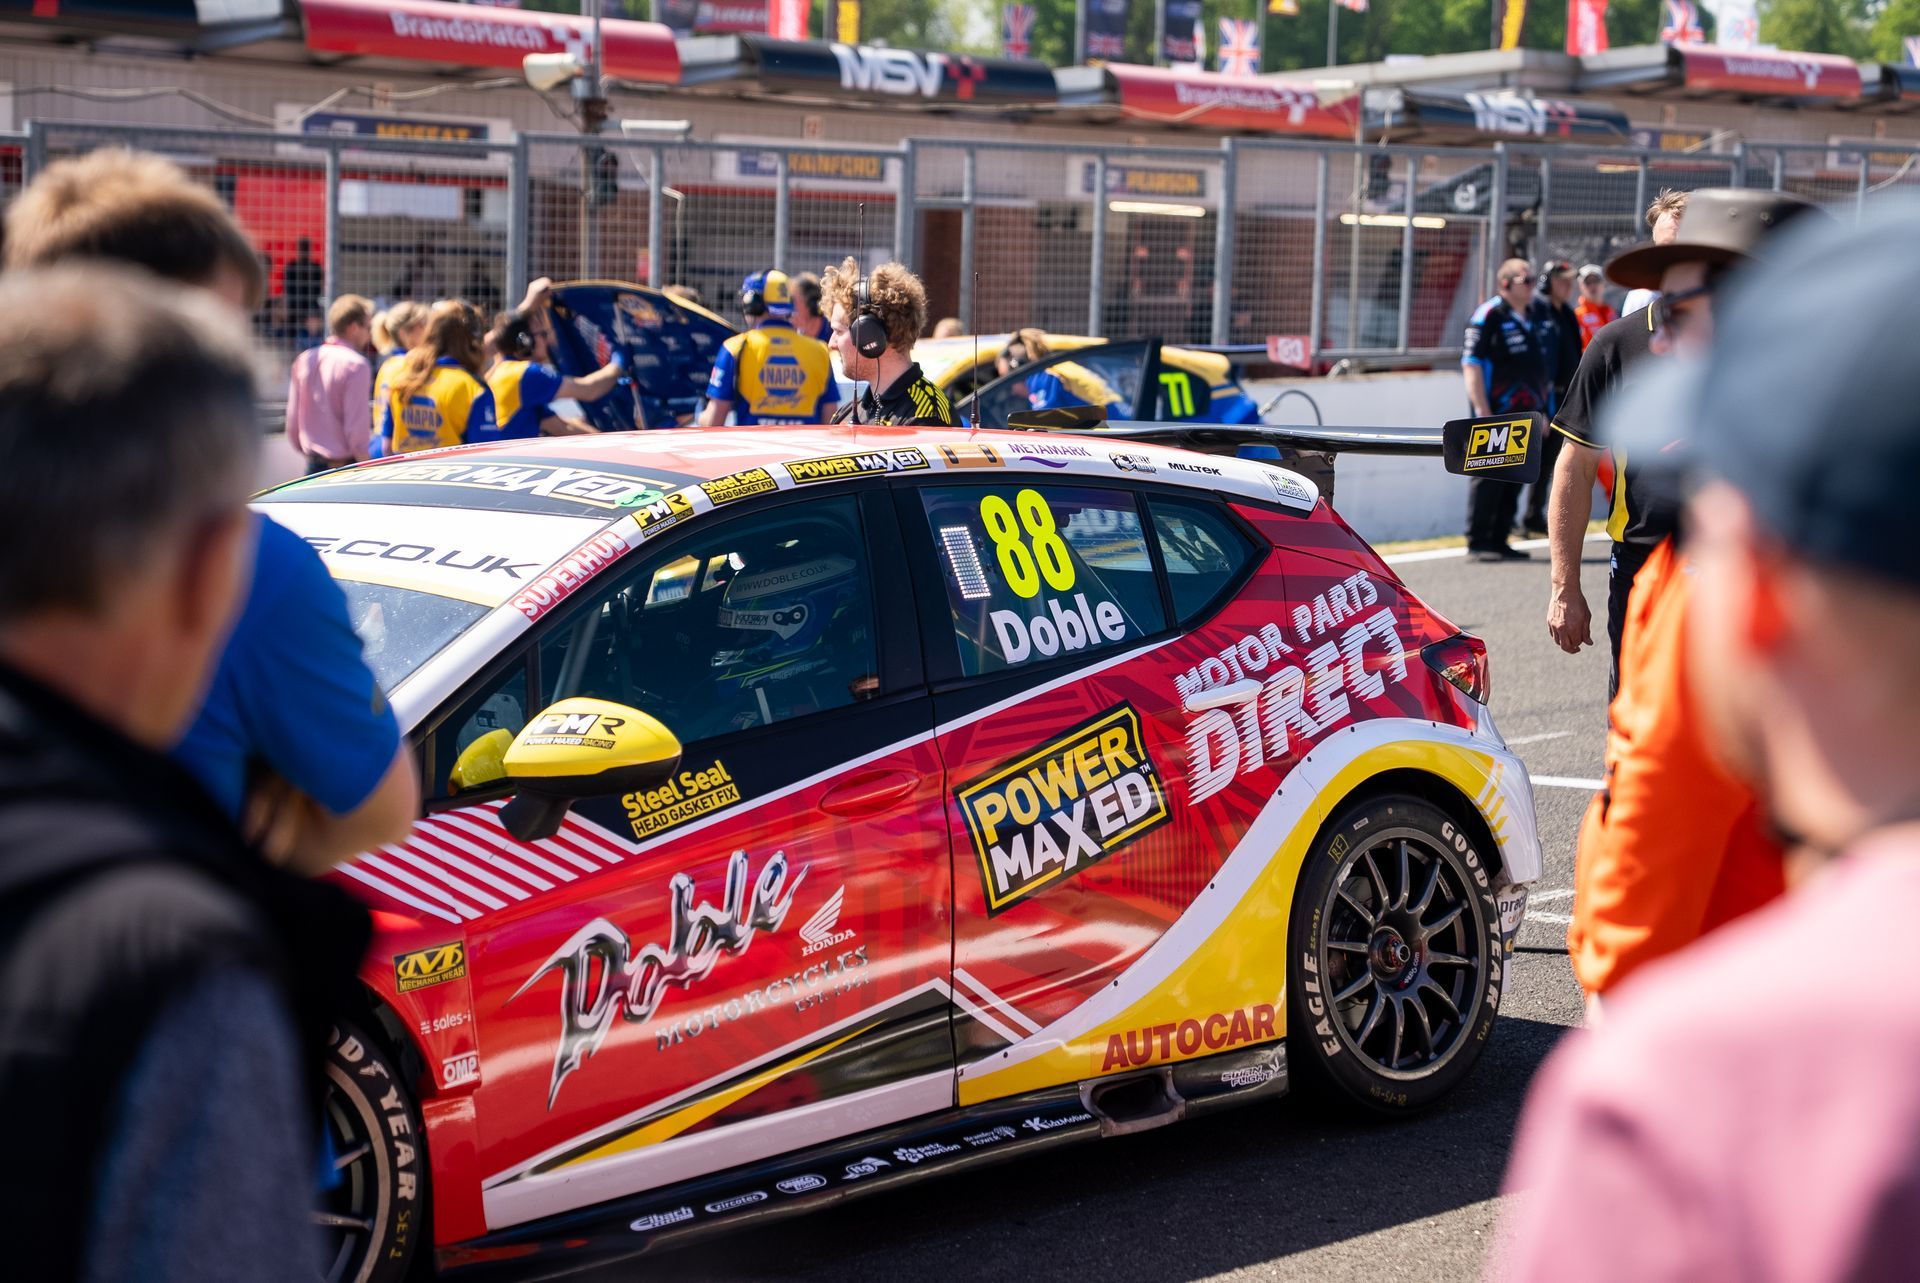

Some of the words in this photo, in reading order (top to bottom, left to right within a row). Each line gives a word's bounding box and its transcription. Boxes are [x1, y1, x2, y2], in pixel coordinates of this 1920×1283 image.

[829, 43, 941, 97] MSV
[766, 366, 800, 386] NAPA
[1159, 372, 1196, 417] 77
[404, 406, 437, 428] NAPA
[1007, 443, 1092, 458] METAMARK
[1470, 425, 1527, 455] PMR
[700, 475, 740, 494] Steel
[735, 468, 770, 485] Seal
[790, 456, 860, 479] POWER
[856, 449, 921, 472] MAXED
[1467, 458, 1486, 469] POWER
[1486, 457, 1505, 466] MAXED
[1505, 455, 1524, 464] RACING
[449, 466, 648, 503] MAXED
[711, 490, 734, 503] HEAD
[732, 483, 761, 498] GASKET
[761, 479, 775, 491] FIX
[632, 493, 688, 527] PMR
[979, 488, 1076, 599] 88
[512, 530, 630, 619] SUPERHUB
[989, 593, 1126, 665] Doble
[1173, 622, 1295, 714] MOTOR
[1291, 569, 1379, 645] PARTS
[532, 713, 626, 736] PMR
[1184, 606, 1408, 807] DIRECT
[621, 777, 684, 819] Steel
[678, 759, 732, 796] Seal
[972, 726, 1138, 847] POWER
[634, 812, 670, 836] HEAD
[668, 793, 717, 821] GASKET
[716, 785, 738, 804] FIX
[989, 771, 1152, 894] MAXED
[1440, 821, 1489, 888] GOOD
[1487, 917, 1503, 1009] YEAR
[801, 928, 856, 957] HONDA
[441, 964, 465, 982] WEAR
[503, 848, 810, 1112] Doble
[655, 944, 871, 1051] MOTORCYCLES
[1304, 951, 1342, 1057] EAGLE
[432, 1010, 472, 1032] sales-i
[1101, 1003, 1276, 1073] AUTOCAR
[442, 1056, 478, 1084] OMP
[379, 1084, 417, 1201] YEAR
[629, 1205, 695, 1232] Eibach
[714, 1194, 759, 1211] zircotec
